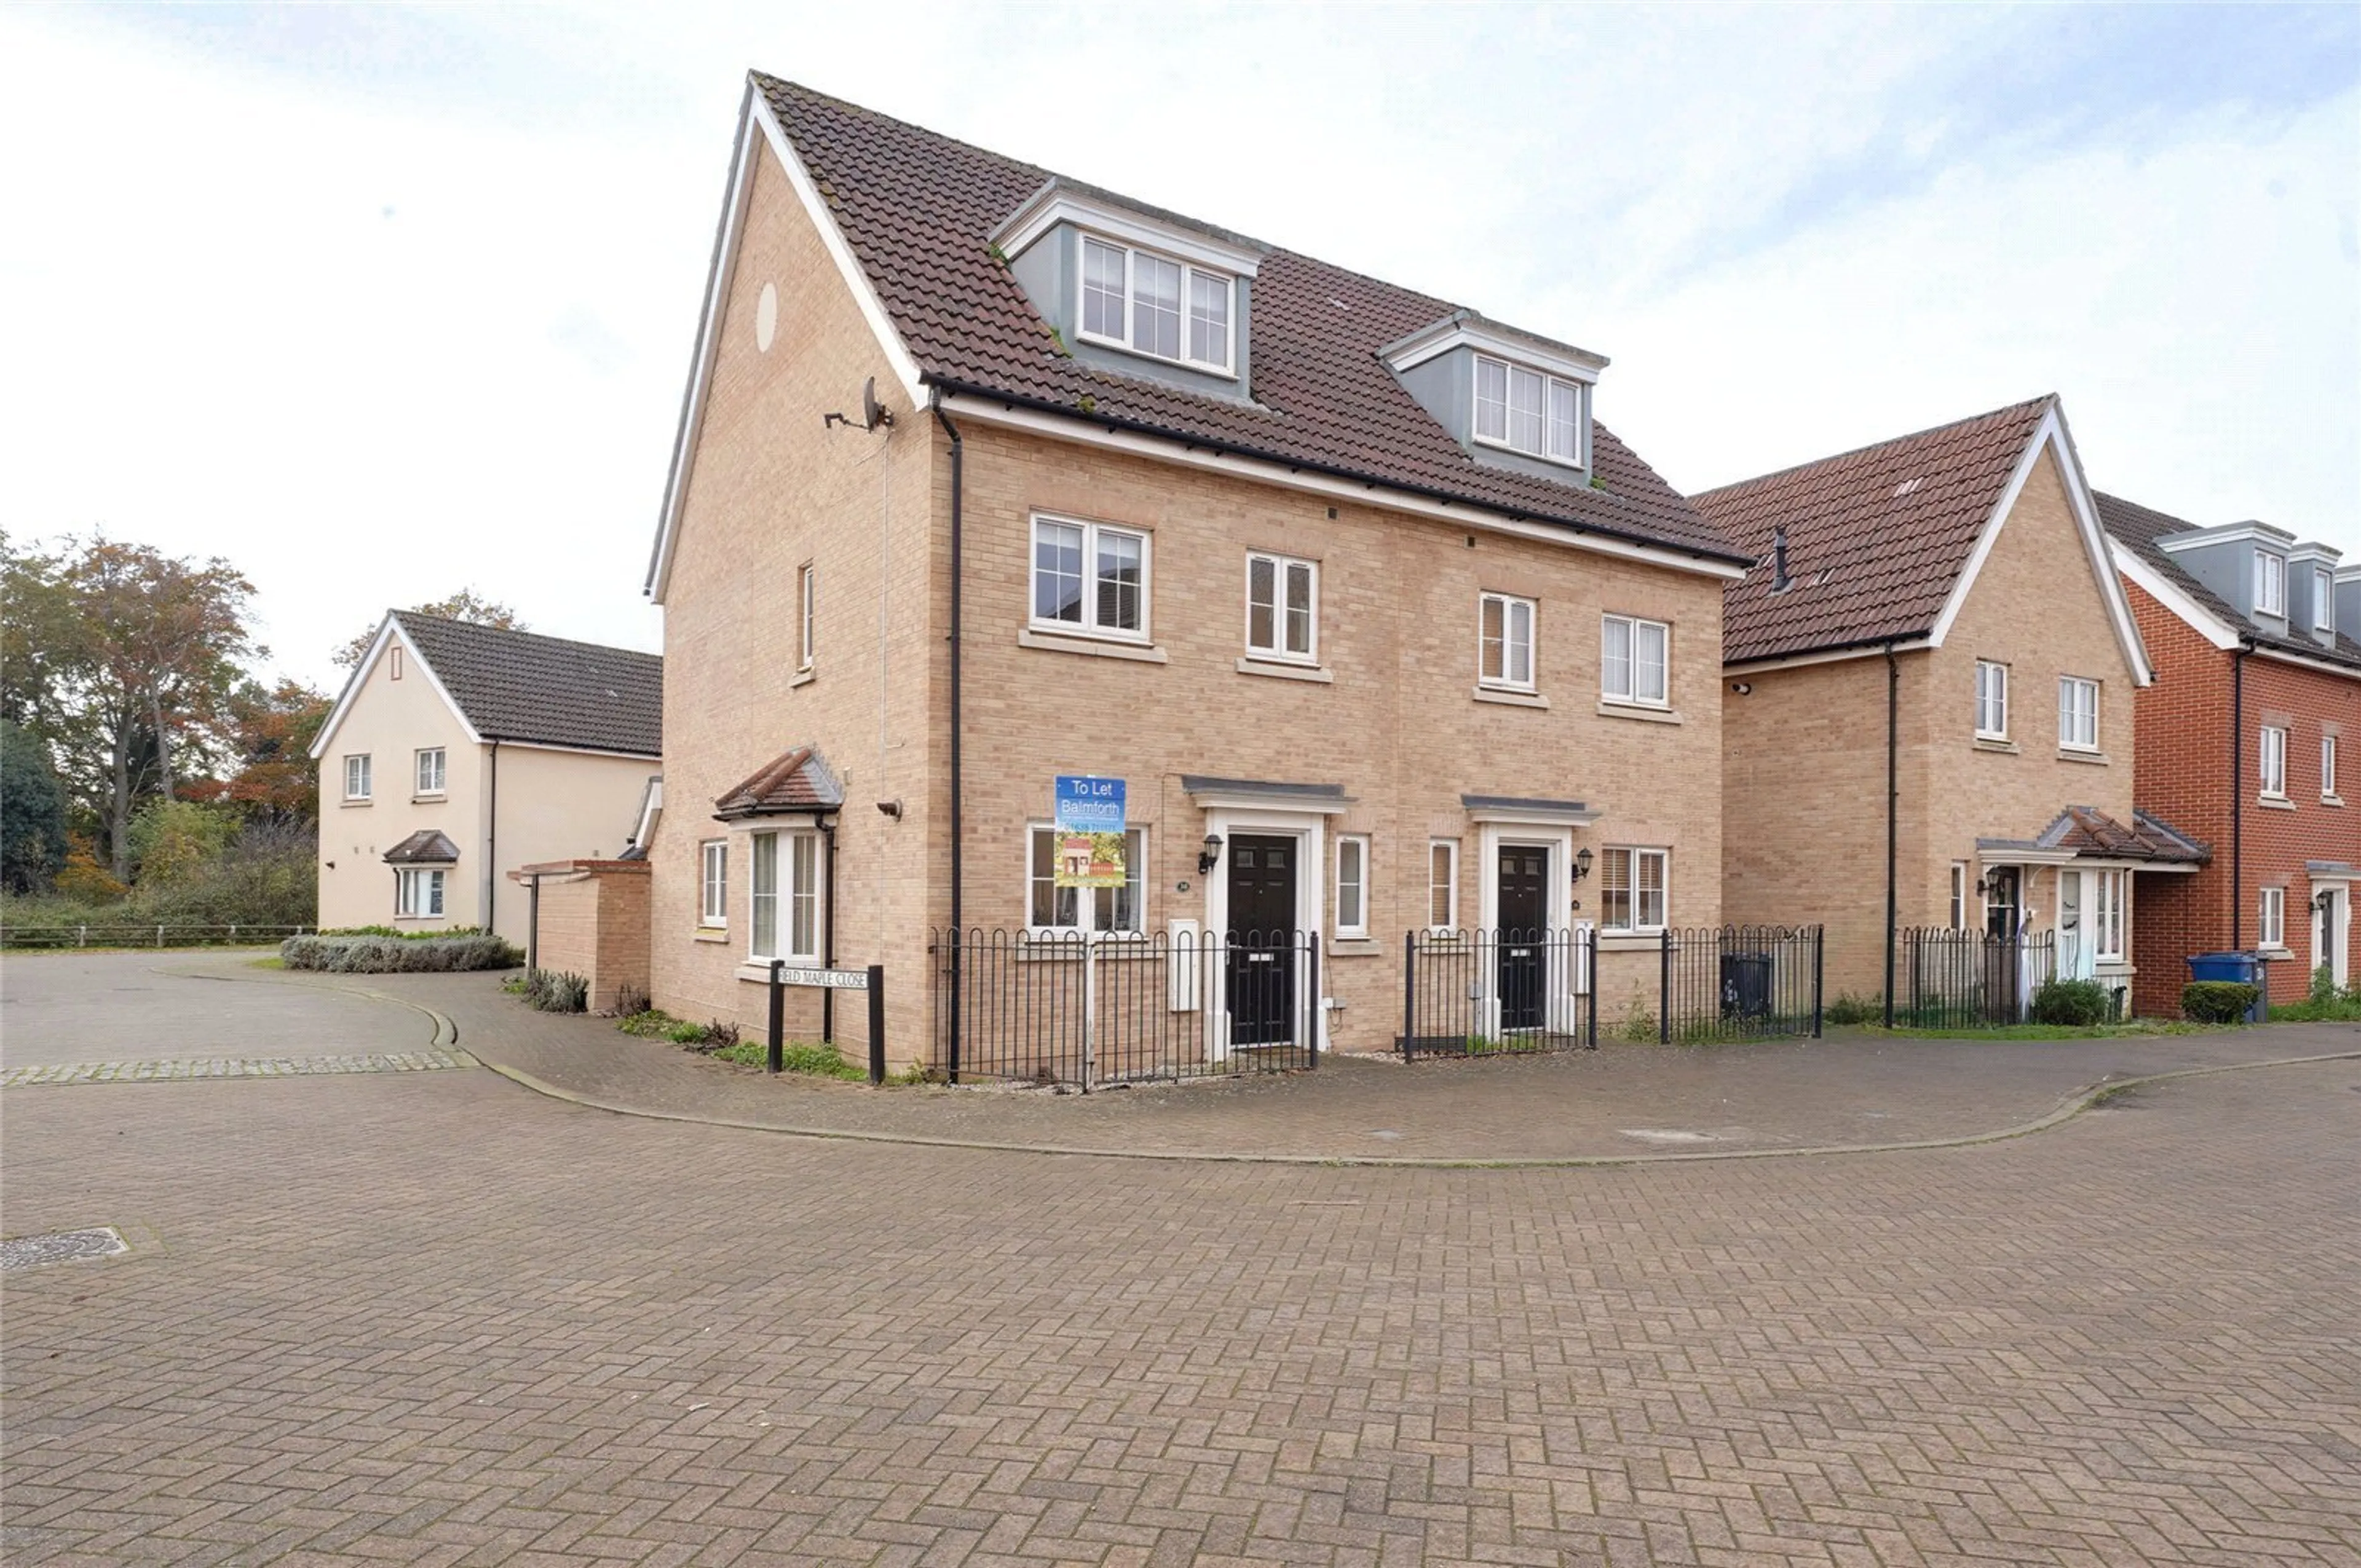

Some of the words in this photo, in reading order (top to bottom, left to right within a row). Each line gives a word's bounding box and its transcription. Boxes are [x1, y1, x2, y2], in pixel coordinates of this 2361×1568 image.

[1072, 780, 1088, 795] To
[1092, 781, 1112, 796] Let
[1062, 800, 1120, 815] Balmforth
[779, 970, 801, 982] FIELD
[803, 972, 834, 985] MAPLE
[835, 973, 865, 987] CLOSE
